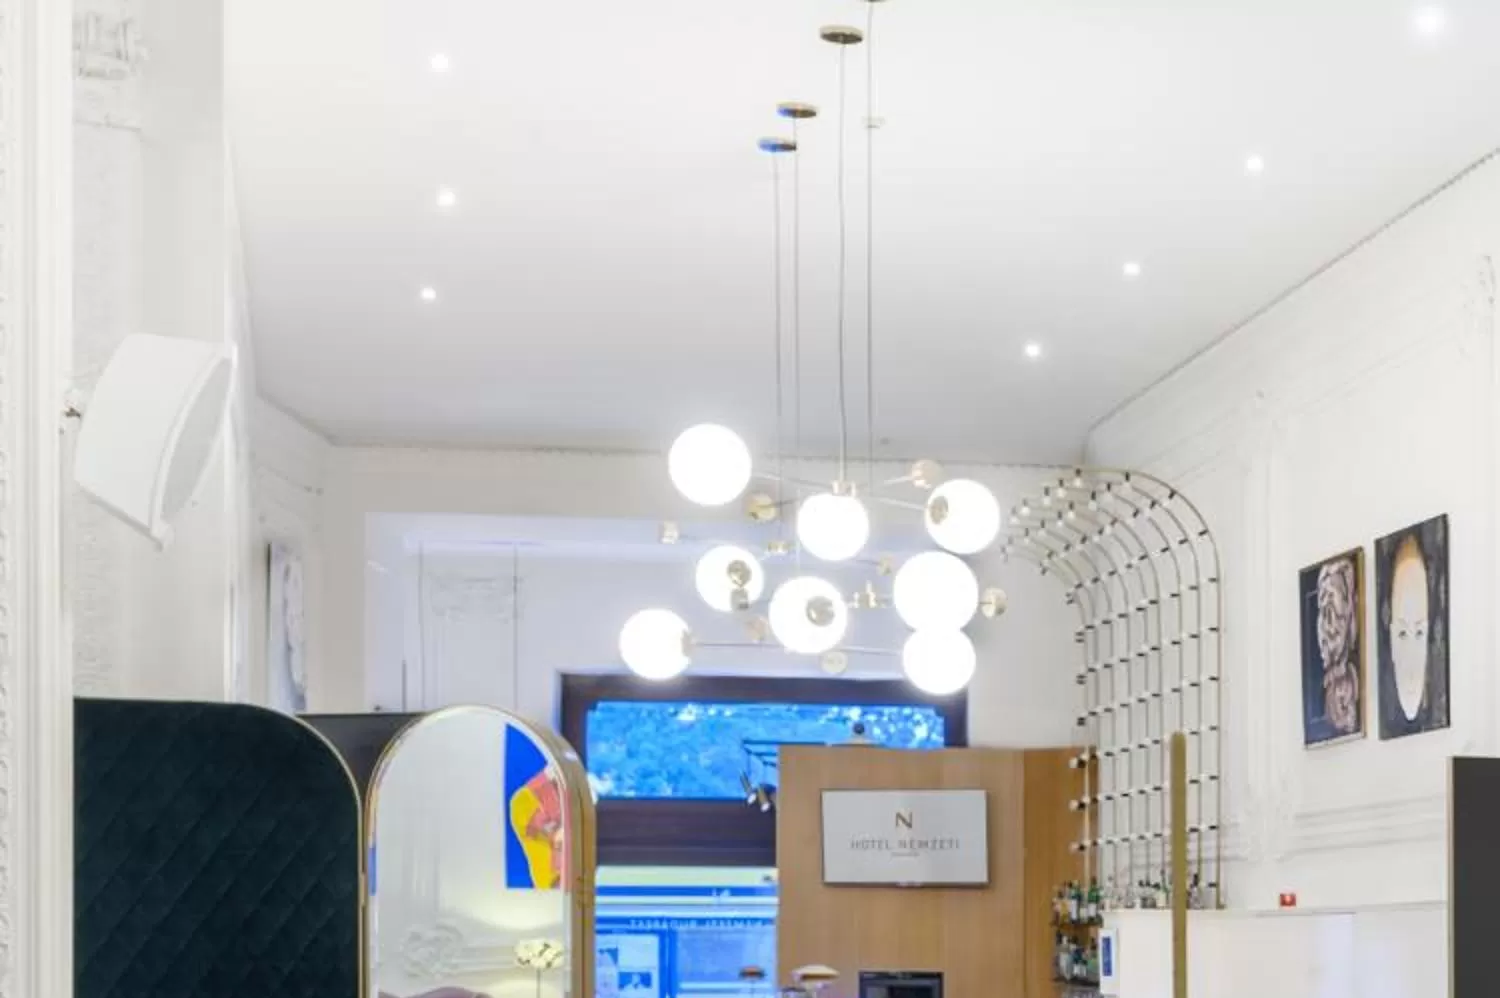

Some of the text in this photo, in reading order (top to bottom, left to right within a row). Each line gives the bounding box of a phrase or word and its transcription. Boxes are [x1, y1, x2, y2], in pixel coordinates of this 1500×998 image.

[895, 811, 914, 829] N
[850, 838, 960, 850] HOTEL NEMZETI
